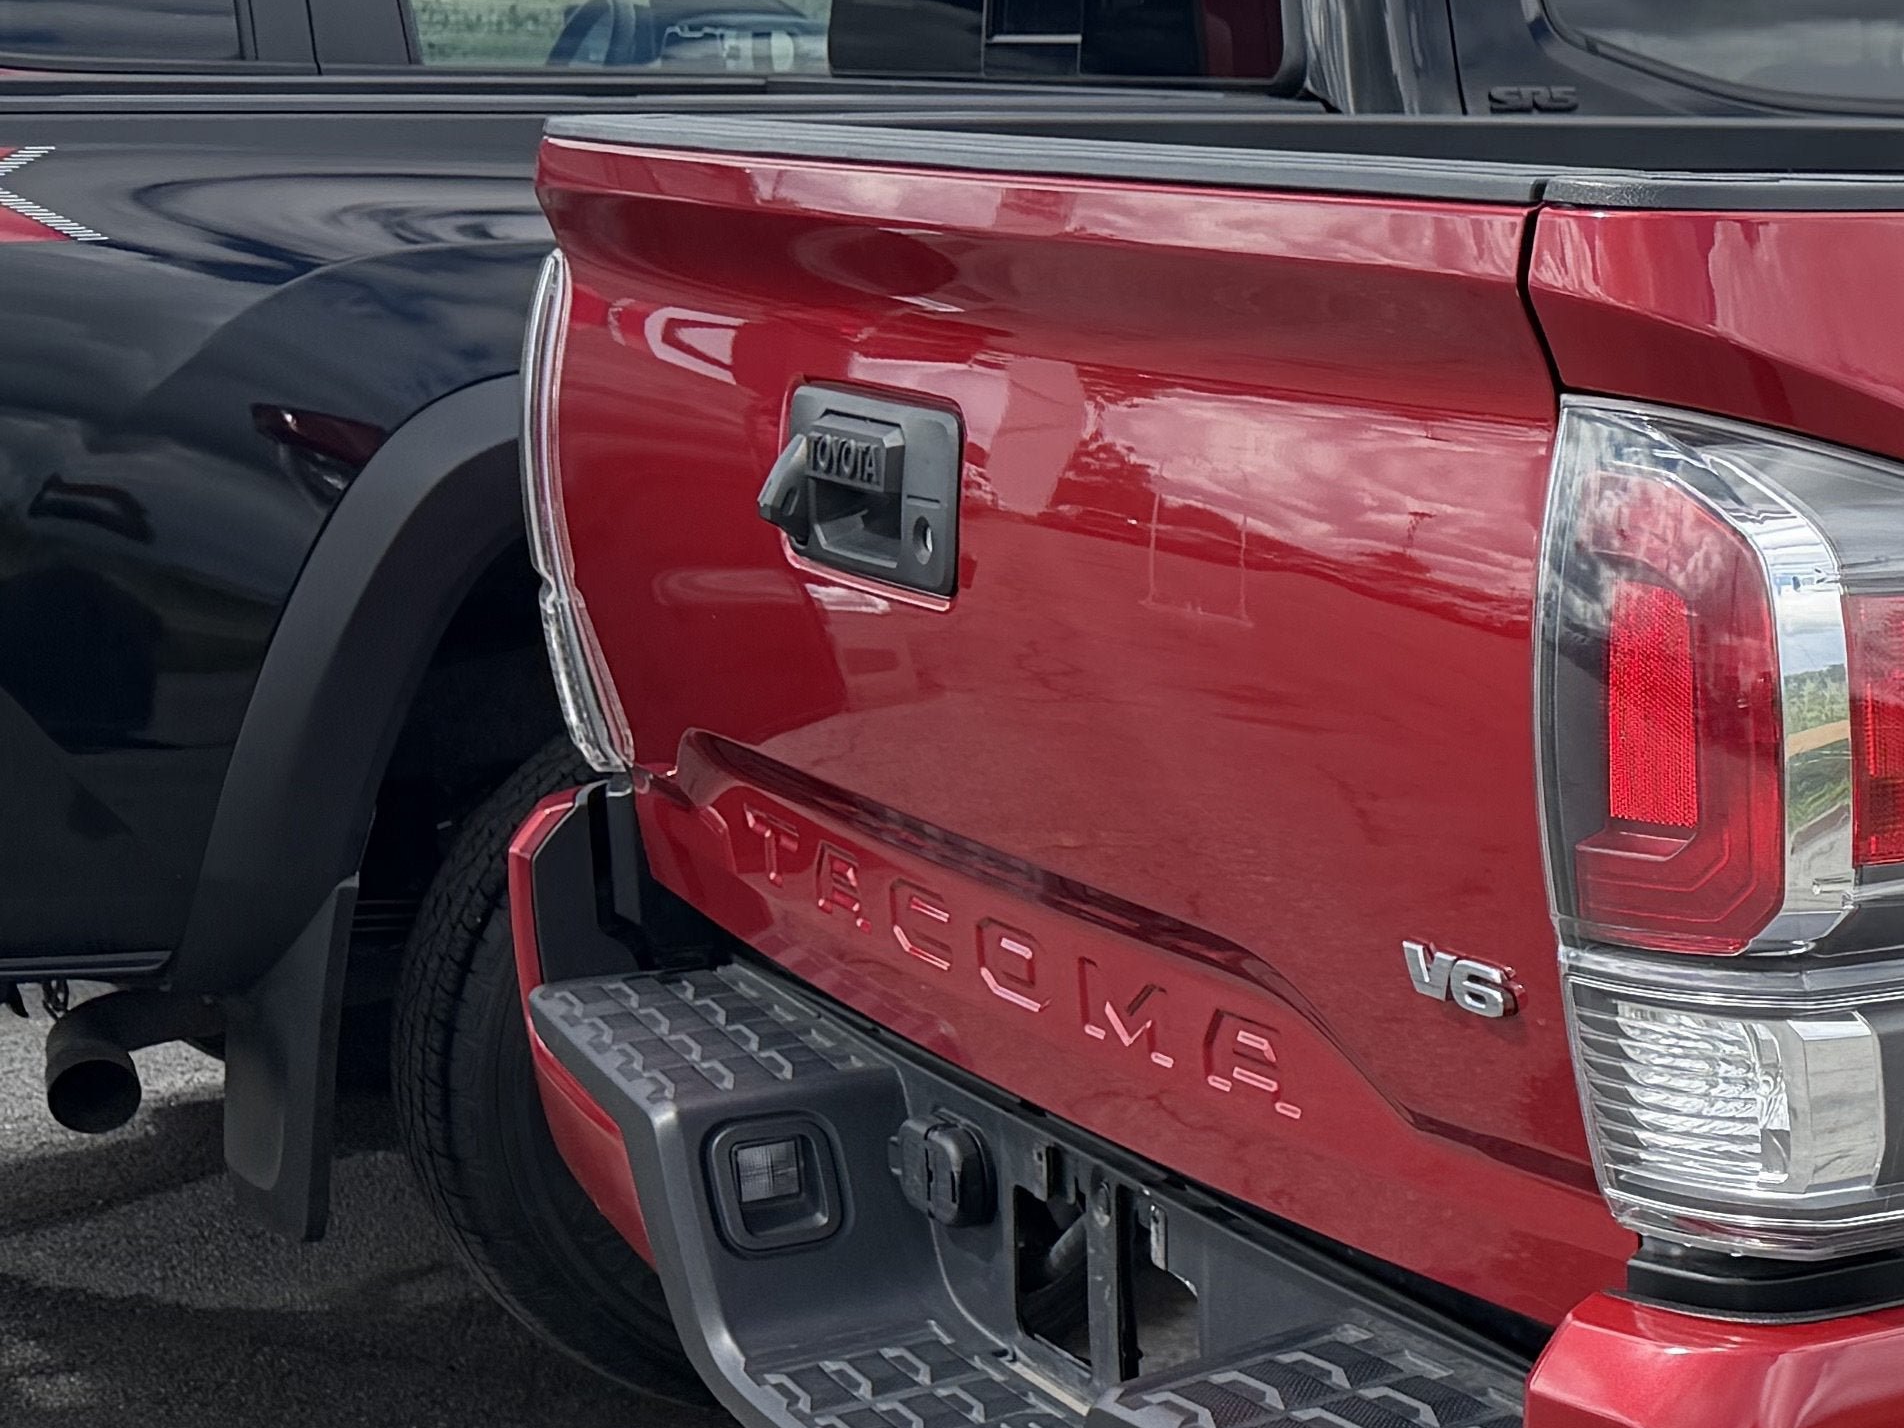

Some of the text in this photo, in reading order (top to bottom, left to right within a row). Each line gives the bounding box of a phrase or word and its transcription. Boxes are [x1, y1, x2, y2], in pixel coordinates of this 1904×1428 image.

[1488, 85, 1579, 114] SR5
[808, 432, 882, 486] TOYOTA
[743, 802, 1302, 1120] TACOMA
[1402, 938, 1520, 1018] V6
